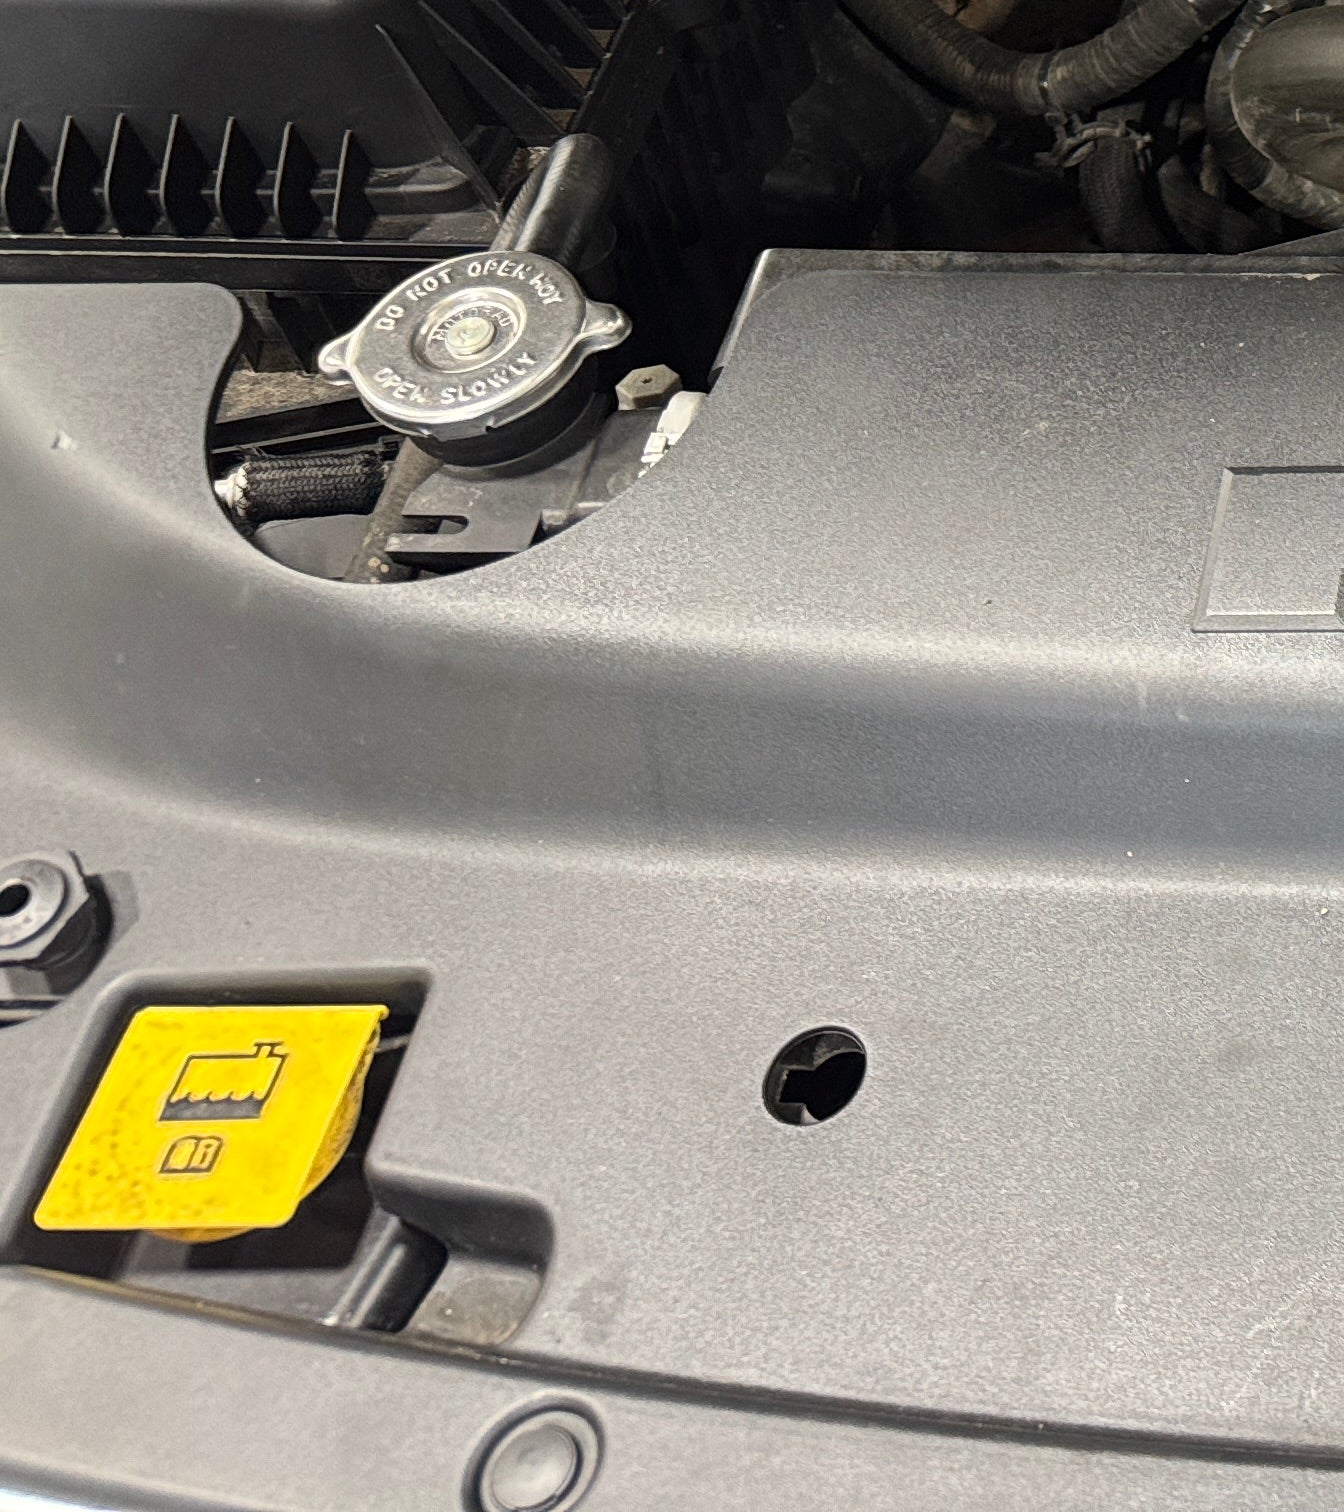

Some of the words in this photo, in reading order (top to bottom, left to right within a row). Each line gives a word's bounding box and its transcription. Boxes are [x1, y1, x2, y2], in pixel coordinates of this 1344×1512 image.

[374, 305, 405, 332] DO
[406, 268, 453, 302] NOT
[467, 261, 533, 281] OPEN
[373, 367, 428, 404] OPEN
[440, 351, 538, 405] SLOWLY
